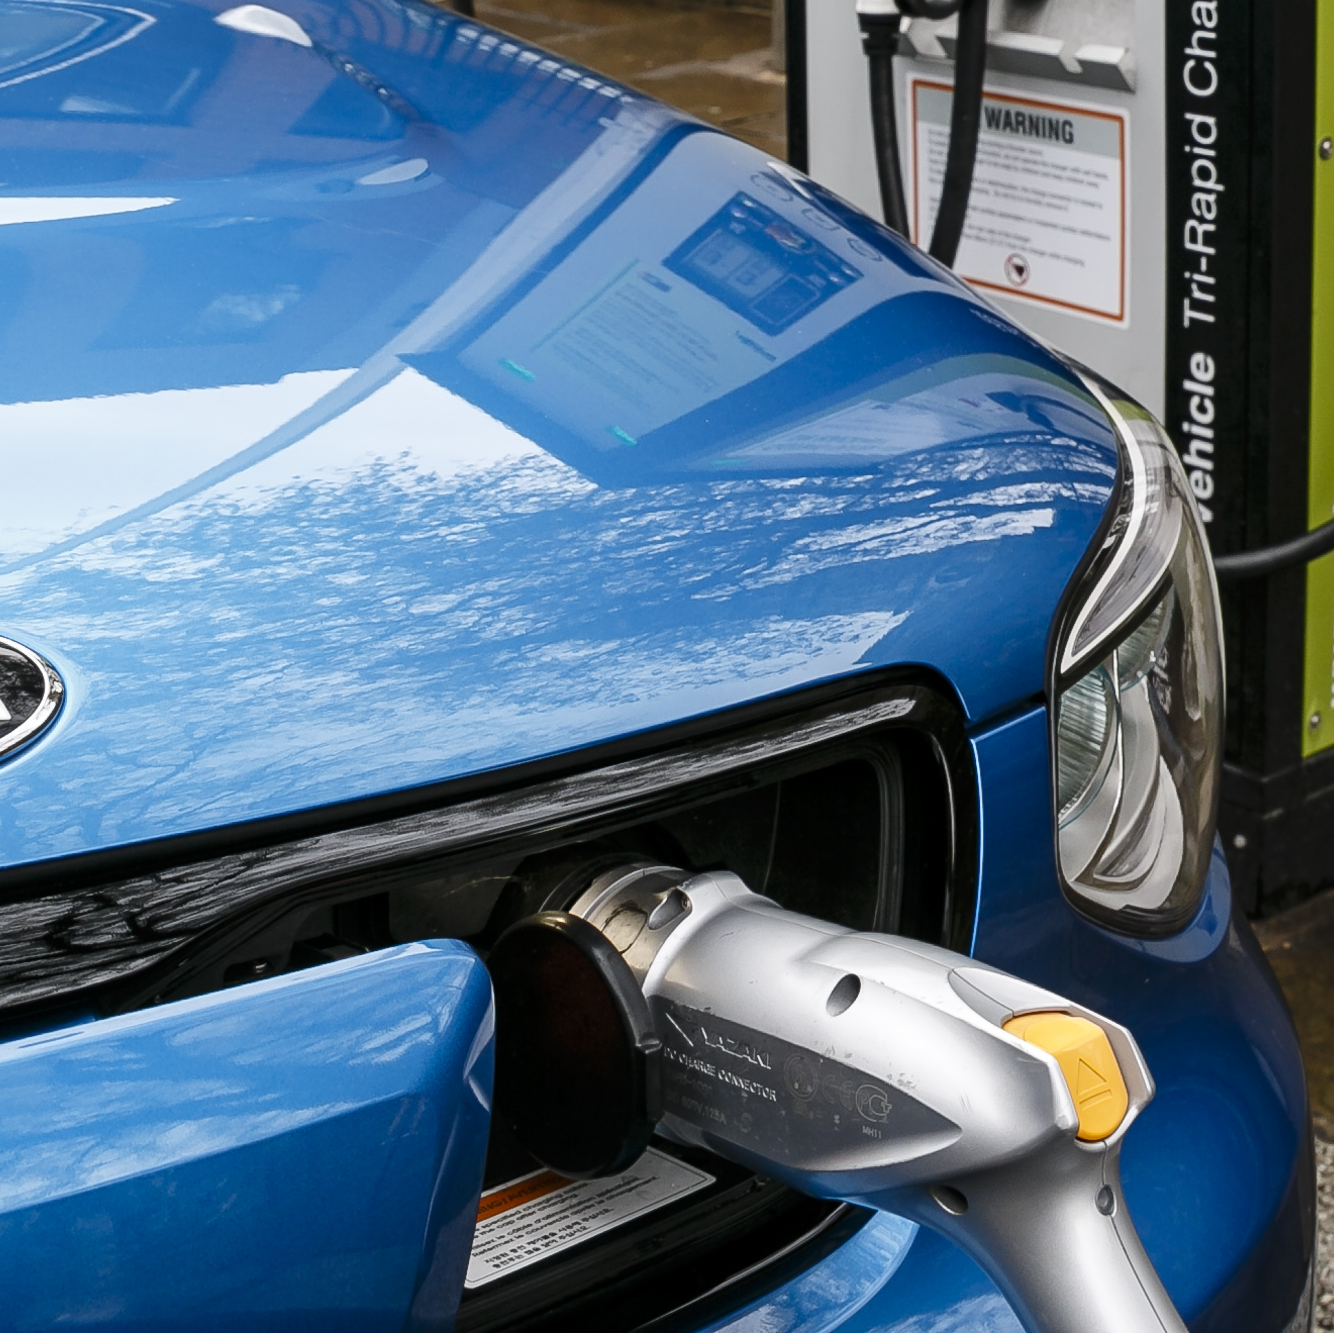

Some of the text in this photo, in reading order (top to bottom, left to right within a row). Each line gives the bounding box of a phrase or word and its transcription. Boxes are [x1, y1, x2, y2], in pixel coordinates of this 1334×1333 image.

[984, 106, 1075, 144] WARNING
[1183, 112, 1226, 329] Tri-Rapid
[717, 1069, 777, 1102] CONNECTOR
